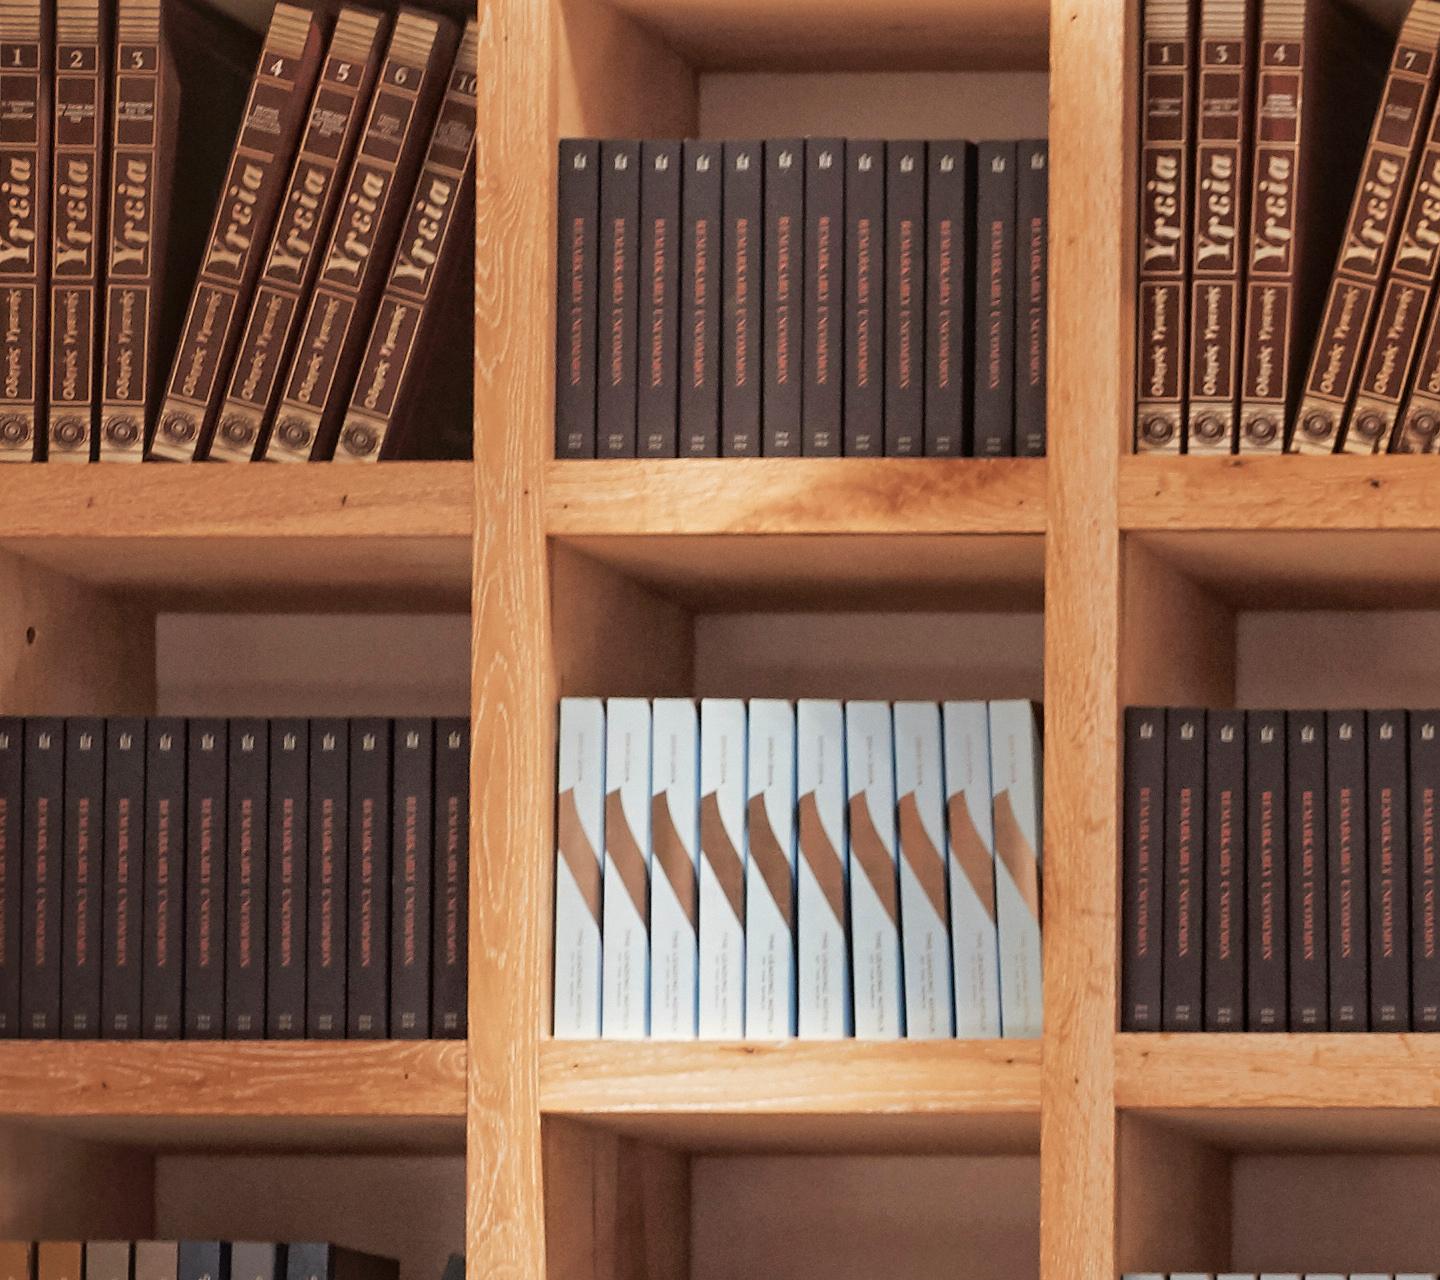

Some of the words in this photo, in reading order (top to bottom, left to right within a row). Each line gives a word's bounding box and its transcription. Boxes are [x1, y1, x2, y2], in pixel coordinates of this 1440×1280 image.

[70, 52, 83, 68] 2
[1274, 46, 1285, 62] 4
[270, 59, 285, 76] 4
[395, 67, 407, 84] 6
